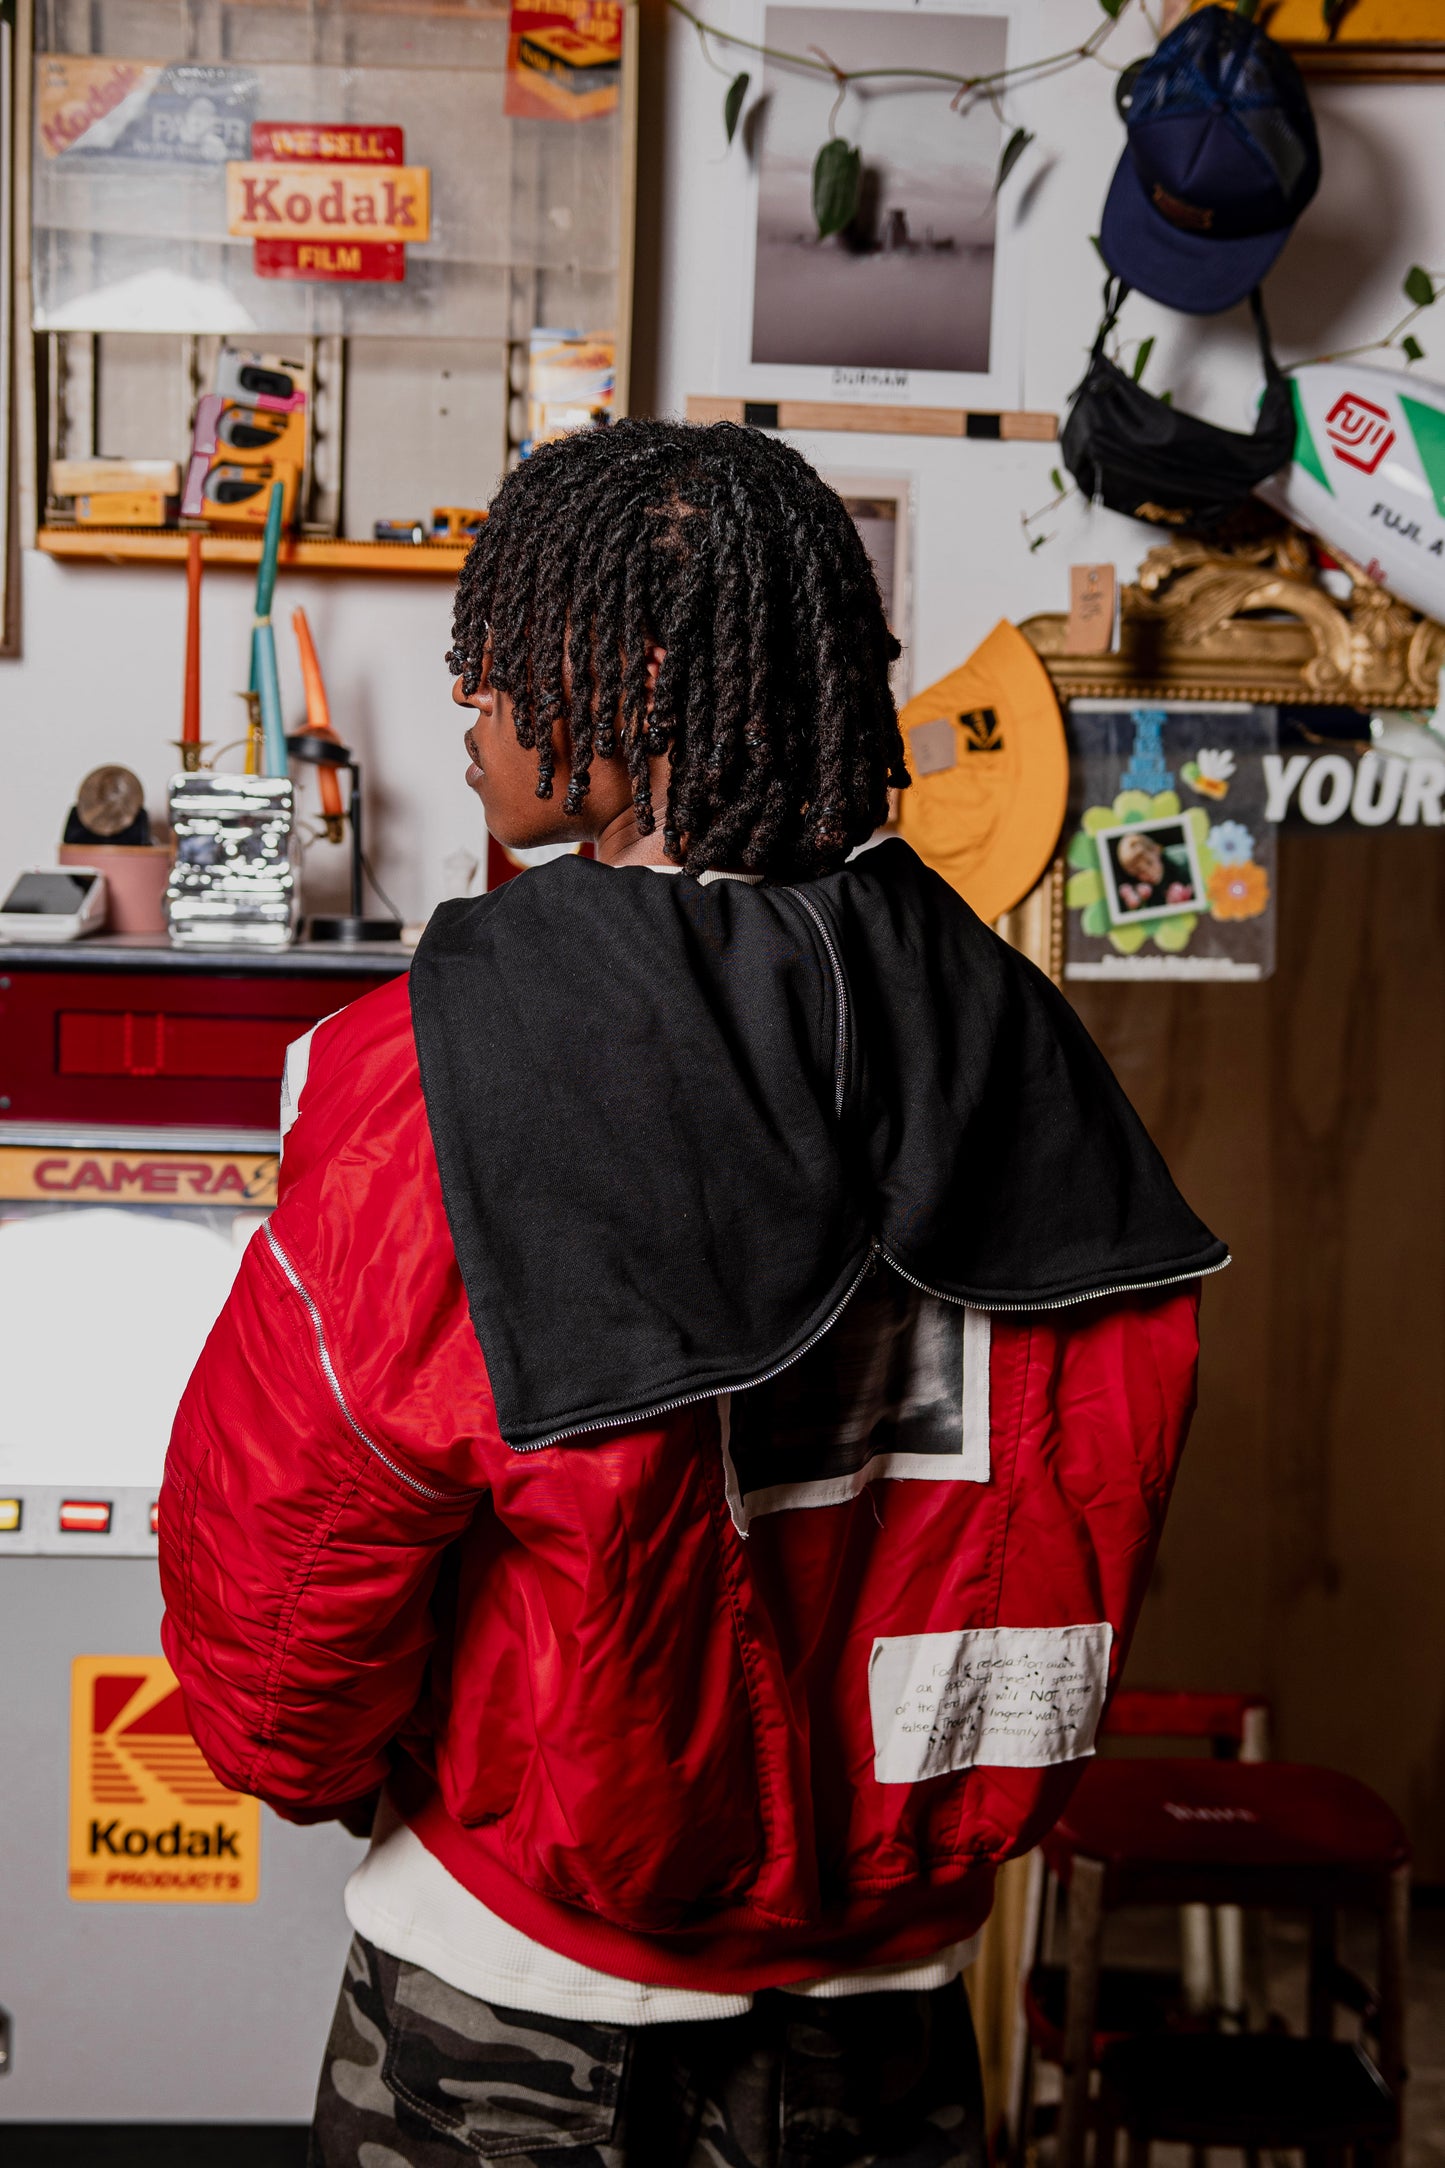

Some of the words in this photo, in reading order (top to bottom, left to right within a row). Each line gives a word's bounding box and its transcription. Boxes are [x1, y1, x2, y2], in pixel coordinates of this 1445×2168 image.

[271, 130, 317, 156] WE
[318, 131, 386, 159] SELL
[240, 177, 417, 227] Kodak
[297, 245, 363, 272] FILM
[33, 1158, 246, 1195] CAMERA
[1030, 1690, 1060, 1702] NOT
[89, 1818, 241, 1859] Kodak
[105, 1869, 242, 1890] PRODUCTS
